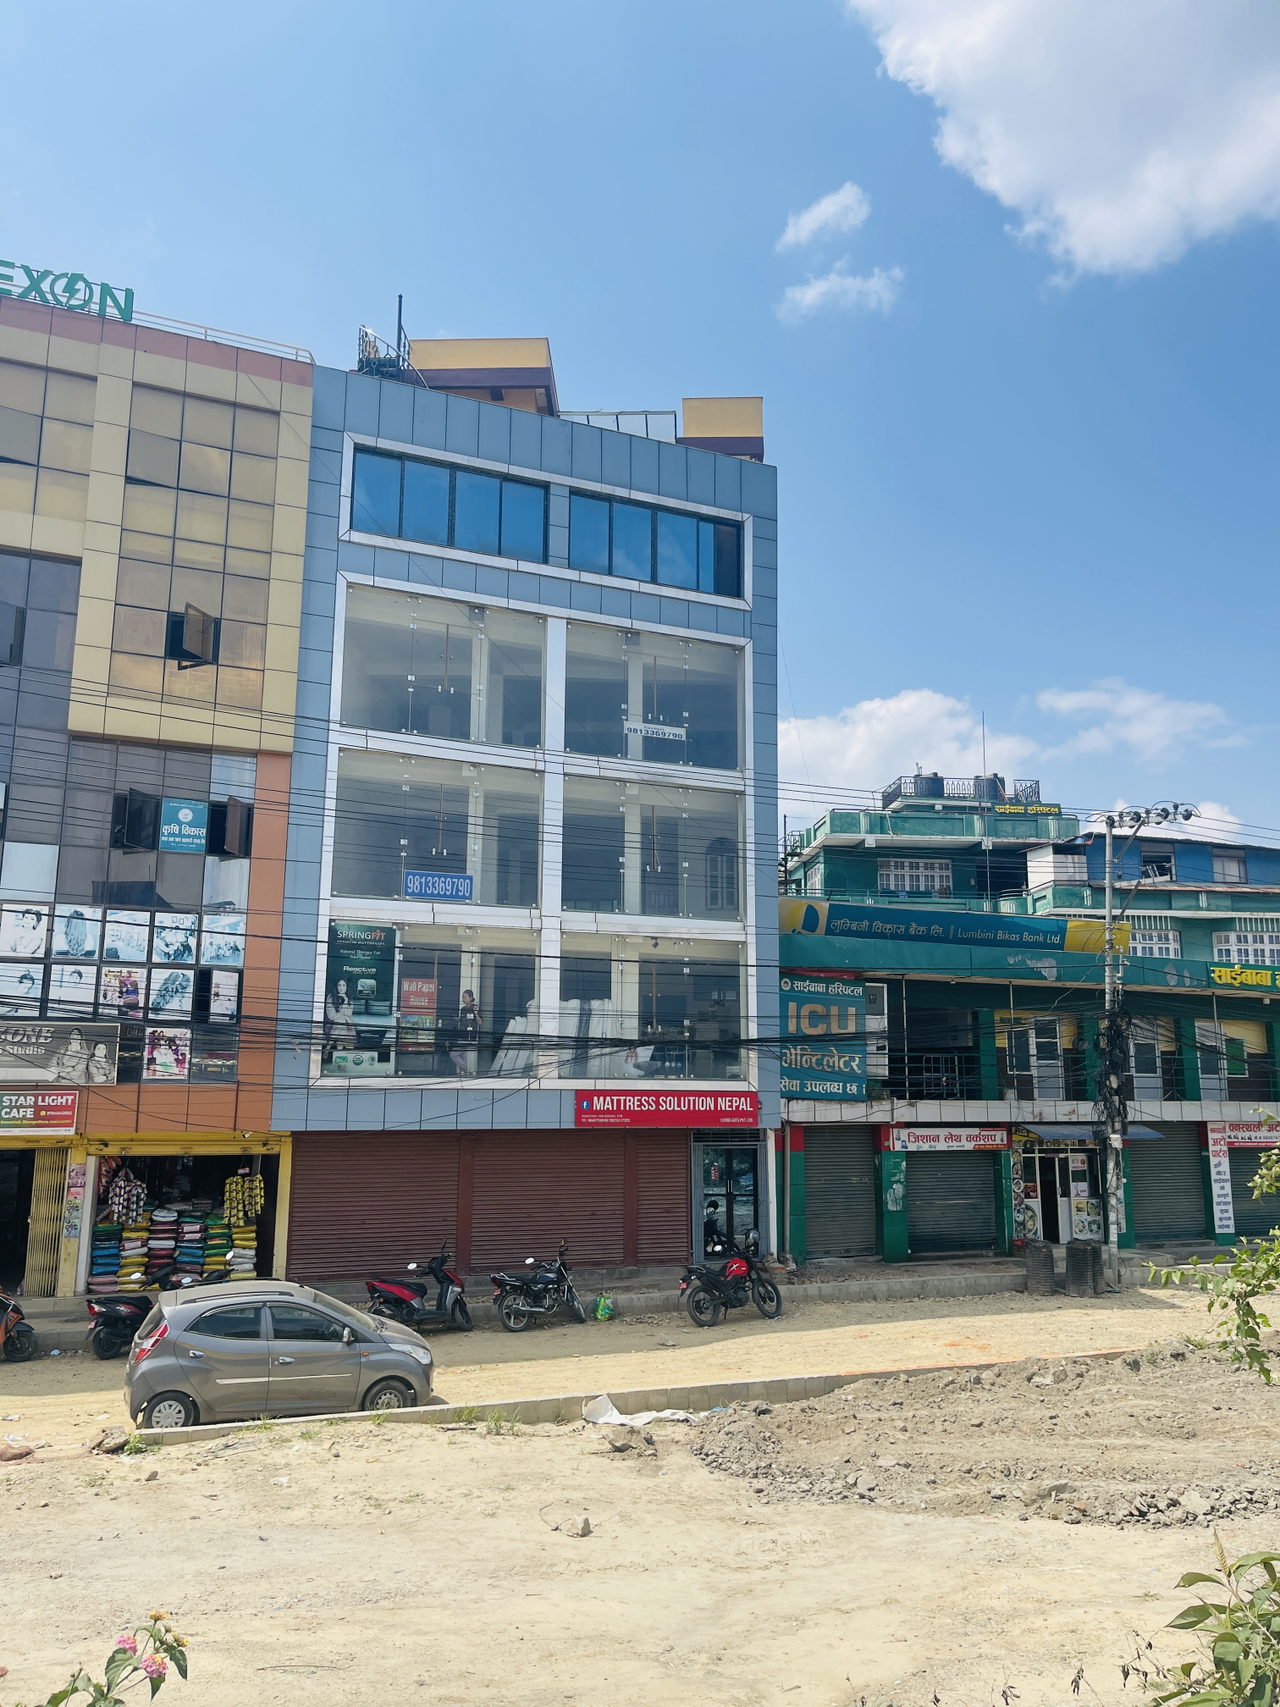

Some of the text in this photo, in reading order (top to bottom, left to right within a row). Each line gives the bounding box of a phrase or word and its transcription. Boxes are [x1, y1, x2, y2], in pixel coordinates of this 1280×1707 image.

[626, 727, 683, 740] 9813369790
[162, 823, 207, 837] कृषि विकास
[407, 875, 471, 897] 9813369790
[872, 920, 906, 935] विकास
[957, 927, 1063, 945] Lumbini Bikas Bank Ltd.
[1210, 964, 1273, 987] साईबाबा
[403, 981, 417, 992] Wall
[793, 980, 826, 993] साईबाबा
[788, 1002, 857, 1036] ICU
[804, 1080, 843, 1094] उपलब्ध
[2, 1095, 75, 1106] STAR LIGHT
[593, 1096, 656, 1111] MATTRESS
[659, 1097, 715, 1111] SOLUTION
[717, 1098, 753, 1111] NEPAL
[1, 1107, 35, 1118] CAFE
